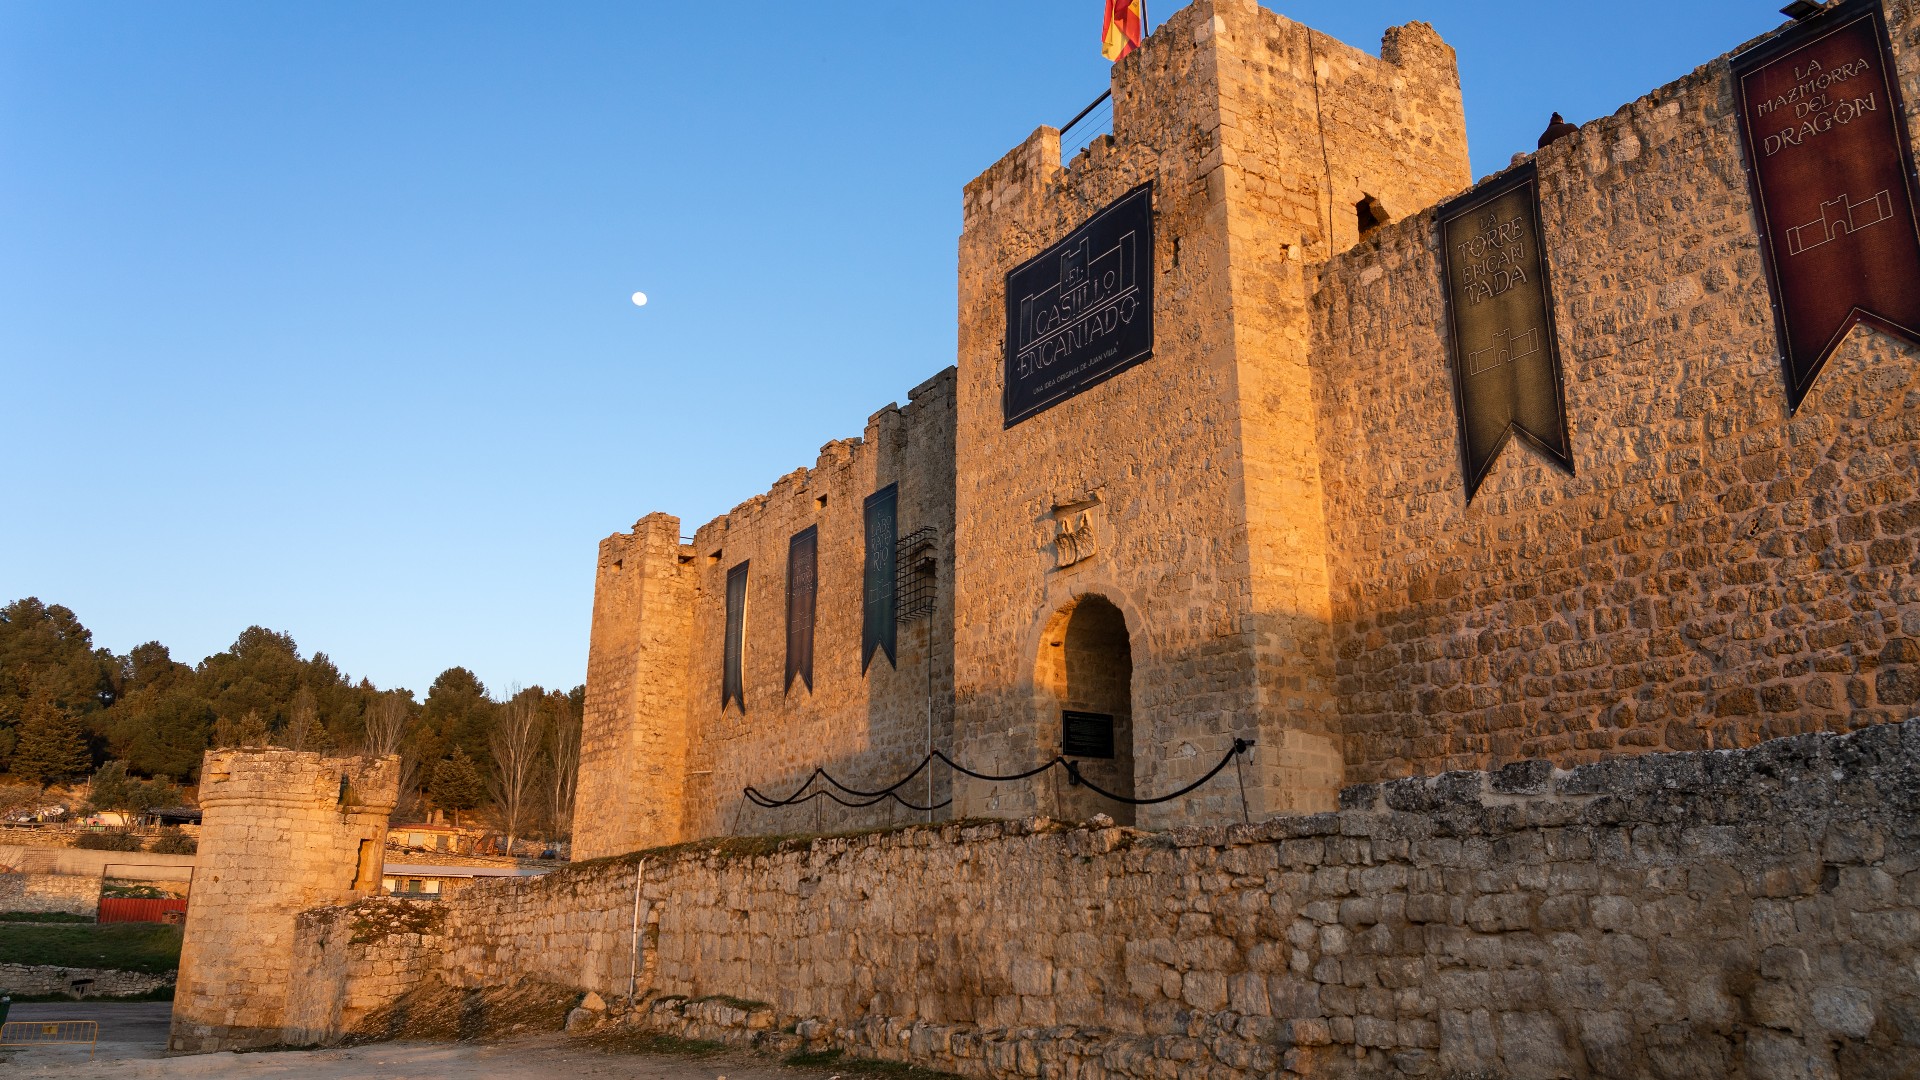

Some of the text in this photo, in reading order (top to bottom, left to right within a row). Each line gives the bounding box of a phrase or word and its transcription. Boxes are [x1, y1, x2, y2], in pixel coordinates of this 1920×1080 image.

[1757, 58, 1870, 117] MAZMORRA
[1794, 59, 1823, 81] LA
[1795, 93, 1834, 119] DEL
[1458, 216, 1523, 262] TORRE
[1480, 213, 1497, 230] LA
[1068, 266, 1084, 288] EL
[1462, 242, 1524, 284] ENCAN
[1036, 270, 1115, 334] CASTILLO
[1463, 265, 1527, 305] TADA
[1019, 296, 1136, 380] ENCANTADO
[1033, 347, 1118, 395] UNA IDEA ORIGINAL DE JUAN VILLA
